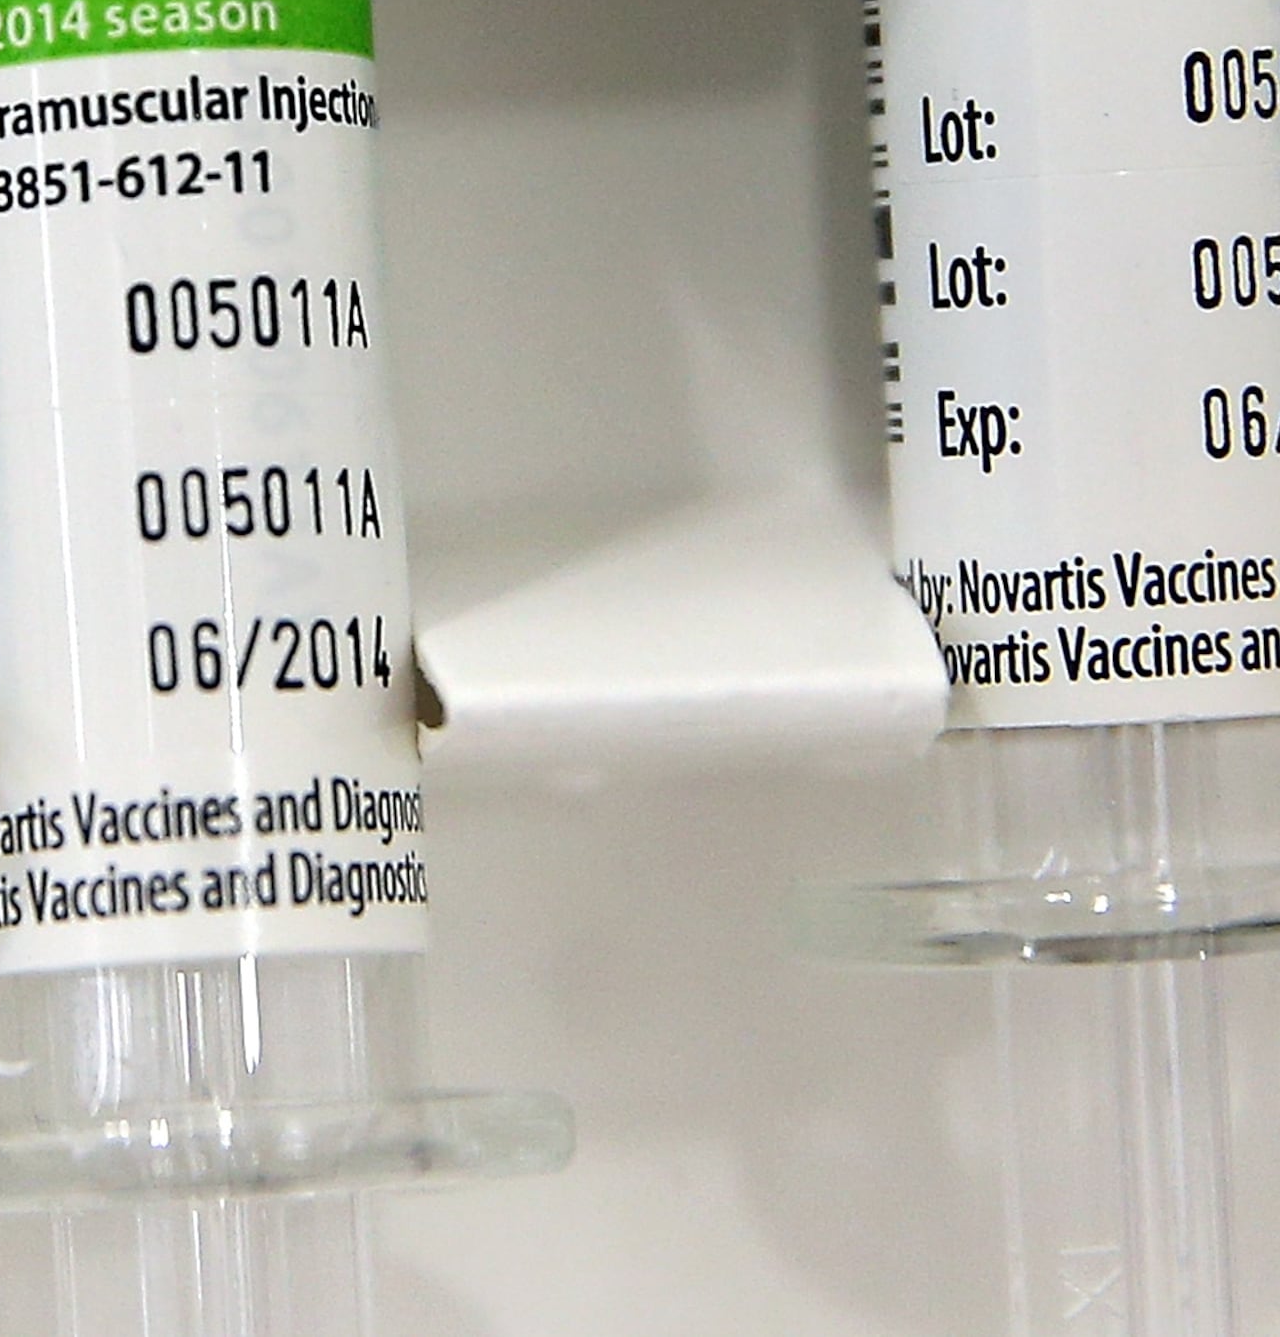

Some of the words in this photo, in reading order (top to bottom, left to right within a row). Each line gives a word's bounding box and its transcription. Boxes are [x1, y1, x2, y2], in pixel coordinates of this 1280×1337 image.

[923, 96, 997, 163] Lot:
[928, 243, 1008, 309] Lot:
[126, 276, 369, 354] 005011A
[937, 390, 1021, 473] Exp:
[136, 466, 382, 541] 005011A
[919, 559, 954, 625] by:
[959, 556, 1106, 617] Novartis
[1113, 549, 1276, 608] Vaccines
[148, 615, 390, 693] 06/2014
[1059, 624, 1232, 685] Vaccines
[72, 788, 243, 845] Vaccines
[257, 779, 322, 835] and
[26, 868, 187, 924] Vaccines
[202, 855, 277, 908] and
